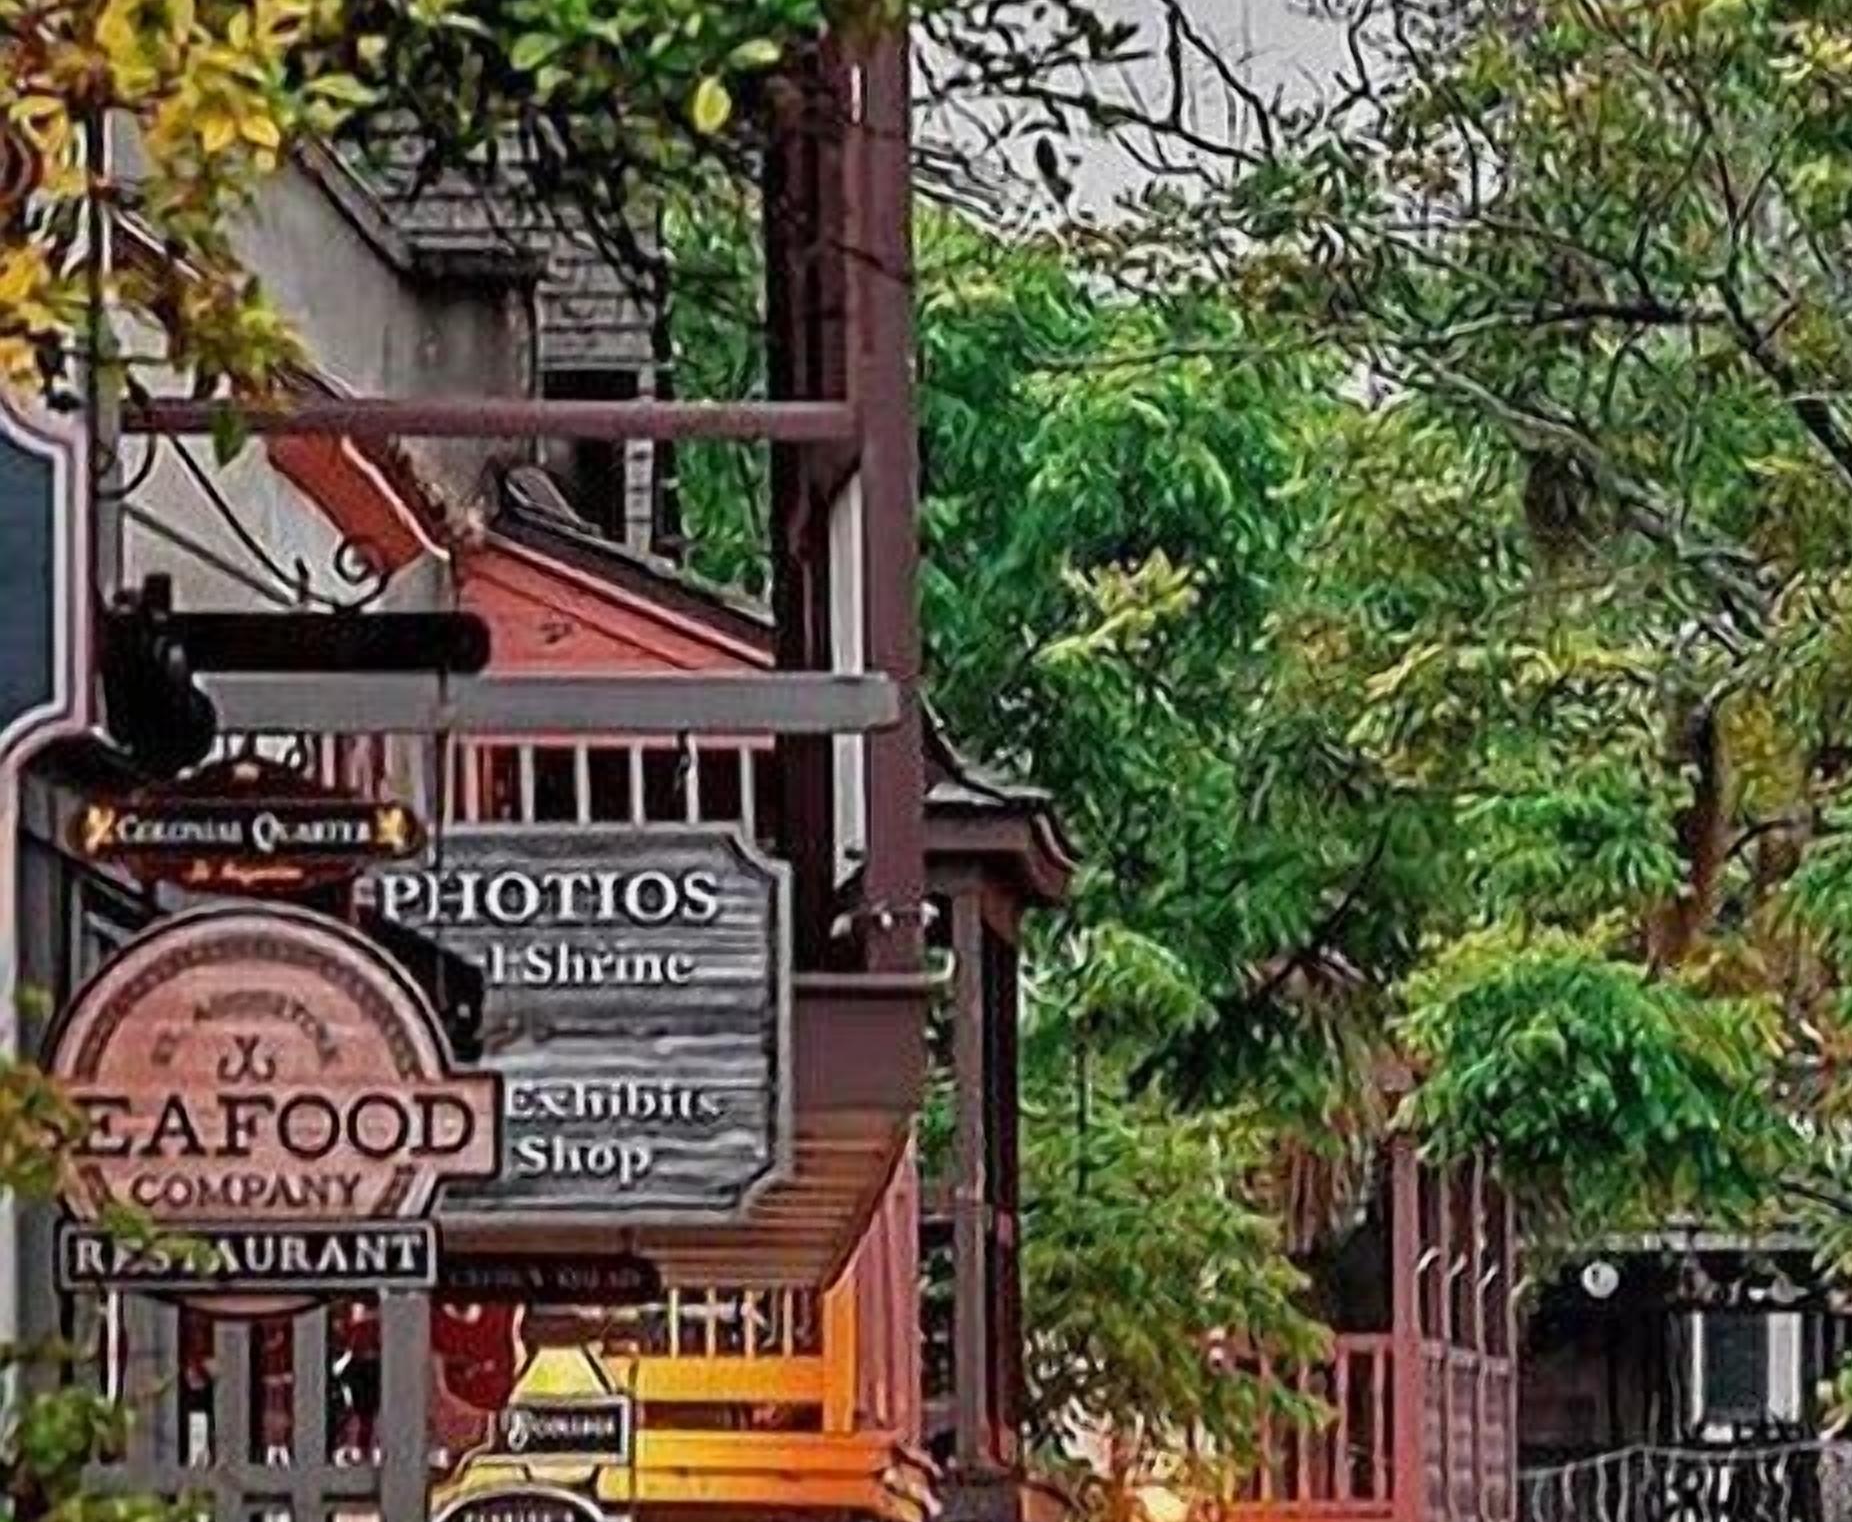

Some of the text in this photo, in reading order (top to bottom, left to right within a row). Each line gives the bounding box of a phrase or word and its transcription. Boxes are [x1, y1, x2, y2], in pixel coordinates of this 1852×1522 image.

[383, 872, 720, 922] PHOTIOS
[524, 943, 695, 984] Shrine
[515, 1134, 652, 1186] Shop
[131, 1172, 360, 1208] COMPANY
